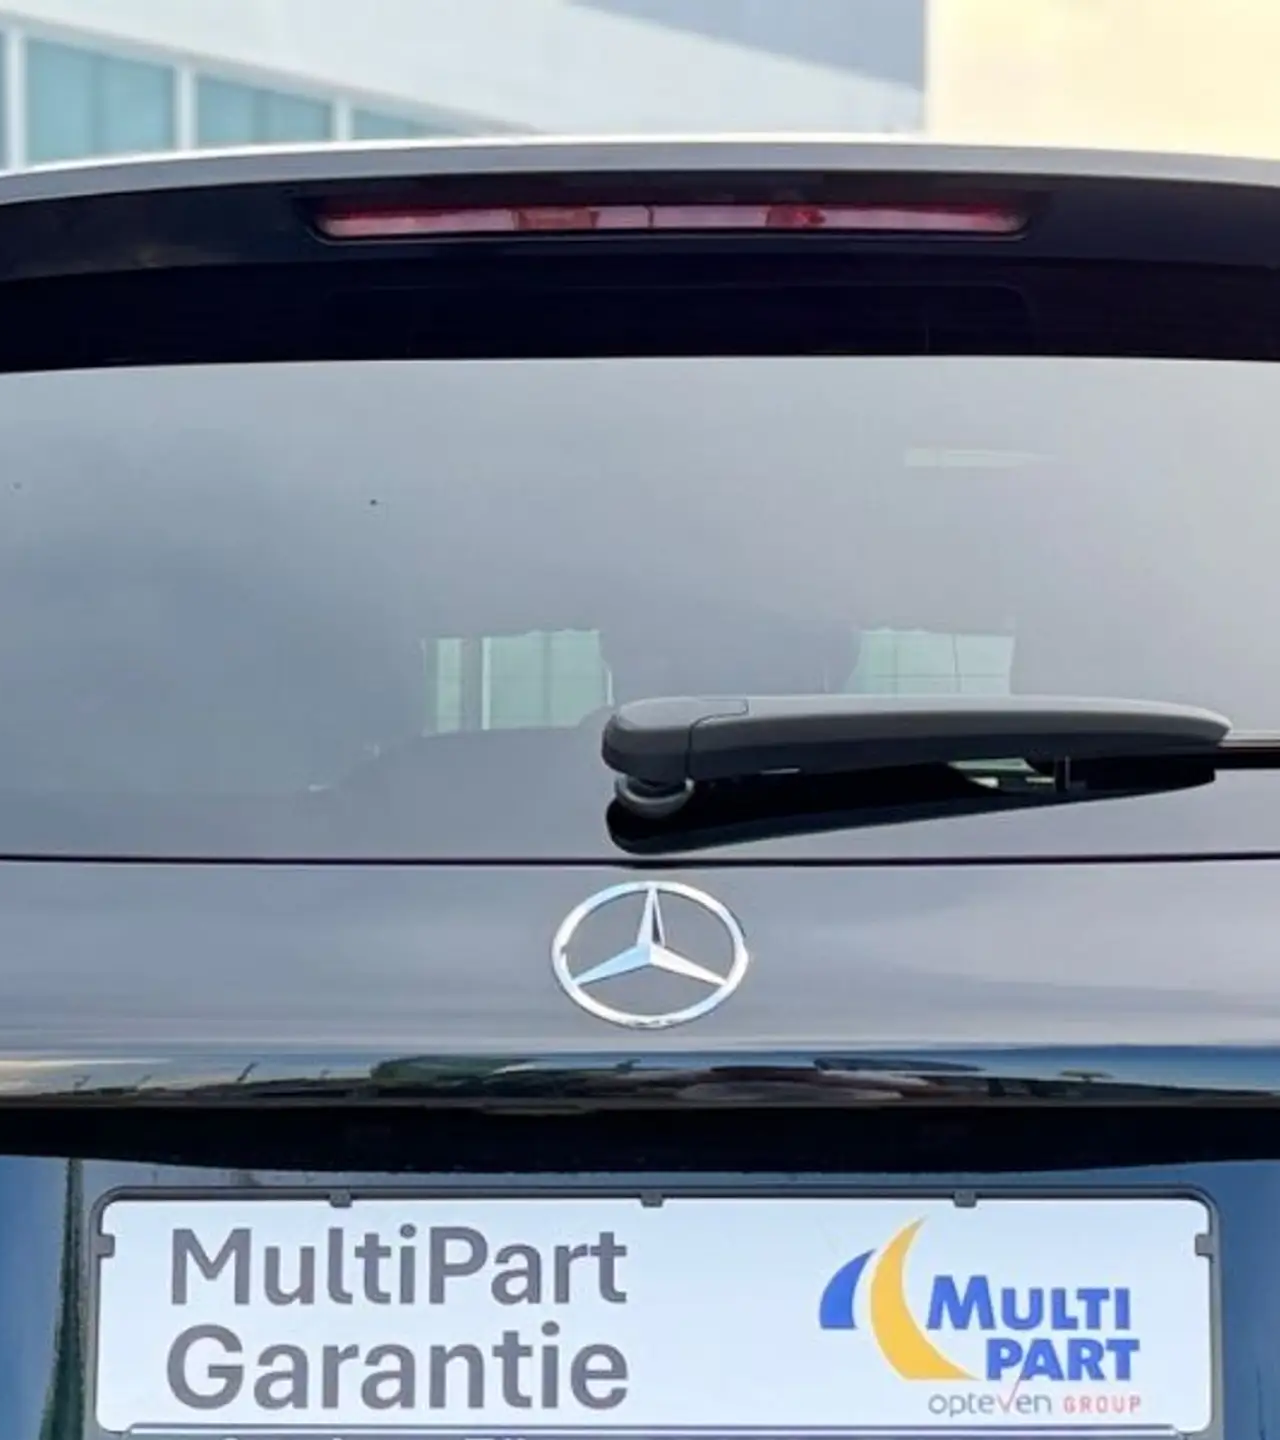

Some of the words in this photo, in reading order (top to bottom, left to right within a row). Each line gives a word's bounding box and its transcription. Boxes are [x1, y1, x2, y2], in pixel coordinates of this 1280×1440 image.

[171, 1224, 628, 1306] MultiPart
[926, 1275, 1131, 1330] MULTI
[166, 1321, 629, 1410] Garantie
[985, 1338, 1140, 1381] PART
[928, 1386, 1053, 1417] opteven
[1063, 1394, 1142, 1414] GROUP
